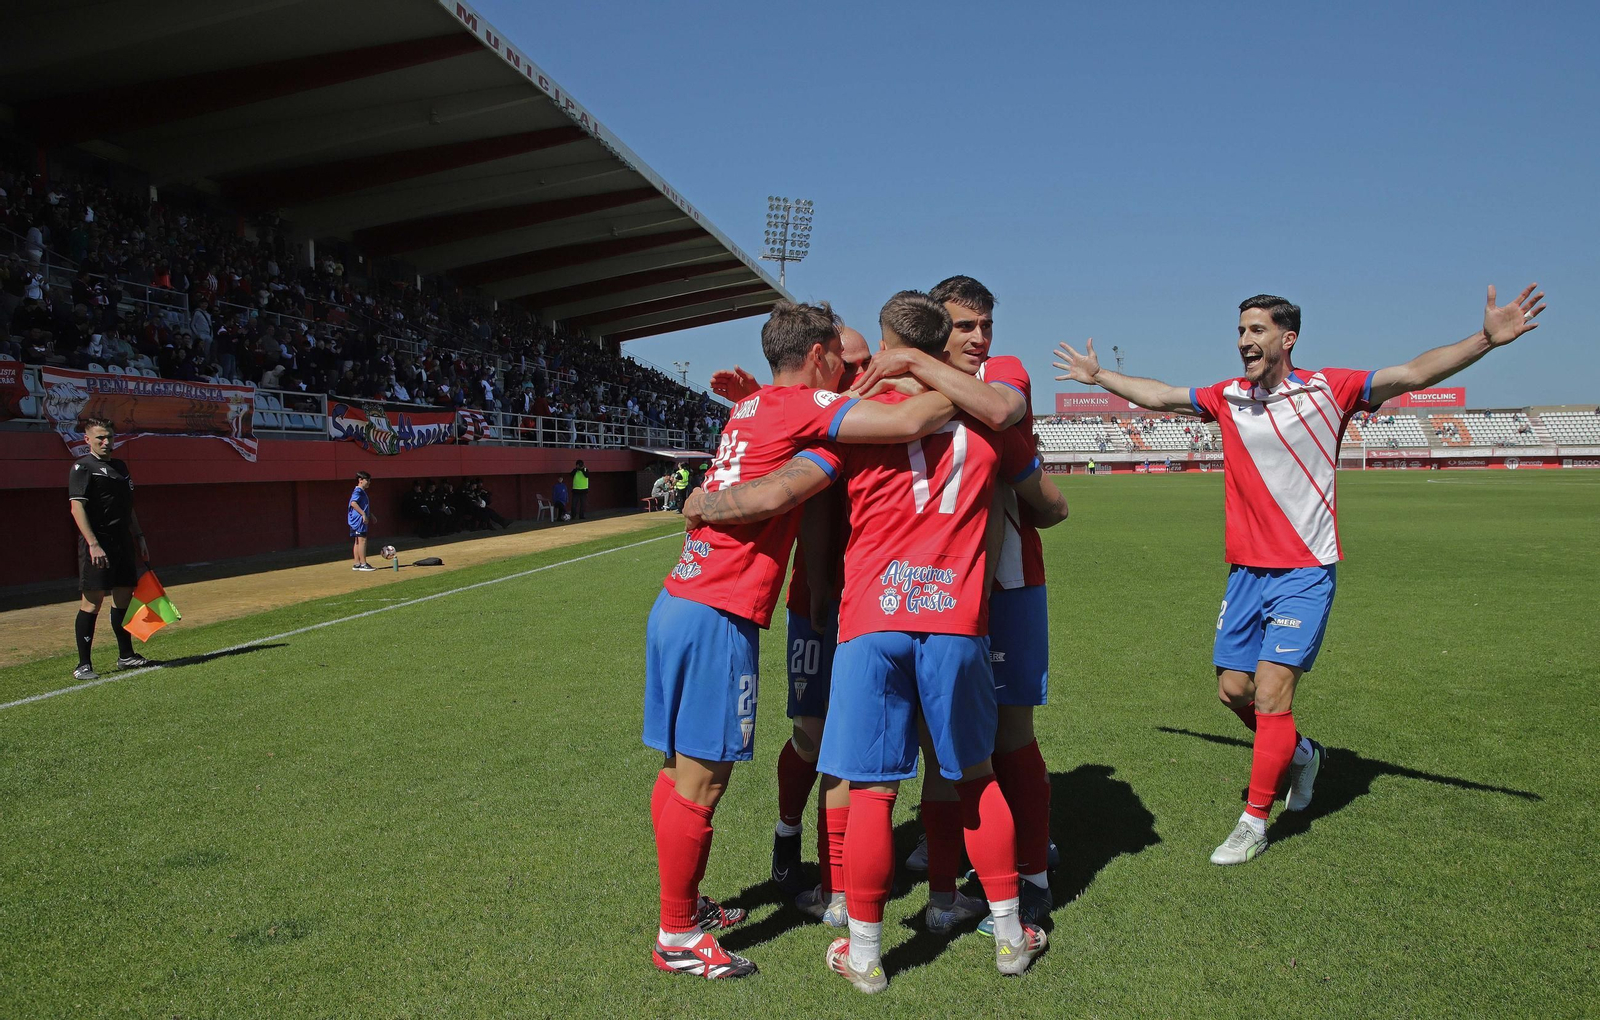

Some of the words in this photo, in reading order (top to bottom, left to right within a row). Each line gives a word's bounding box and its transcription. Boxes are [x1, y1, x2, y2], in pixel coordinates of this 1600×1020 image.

[456, 2, 601, 136] MUNICIPAL
[662, 184, 699, 220] NUEVO
[1409, 392, 1457, 400] MEDYCLINIC
[906, 421, 968, 514] 17
[880, 560, 957, 593] Algeciras
[906, 586, 957, 614] Gusta
[791, 638, 820, 675] 20
